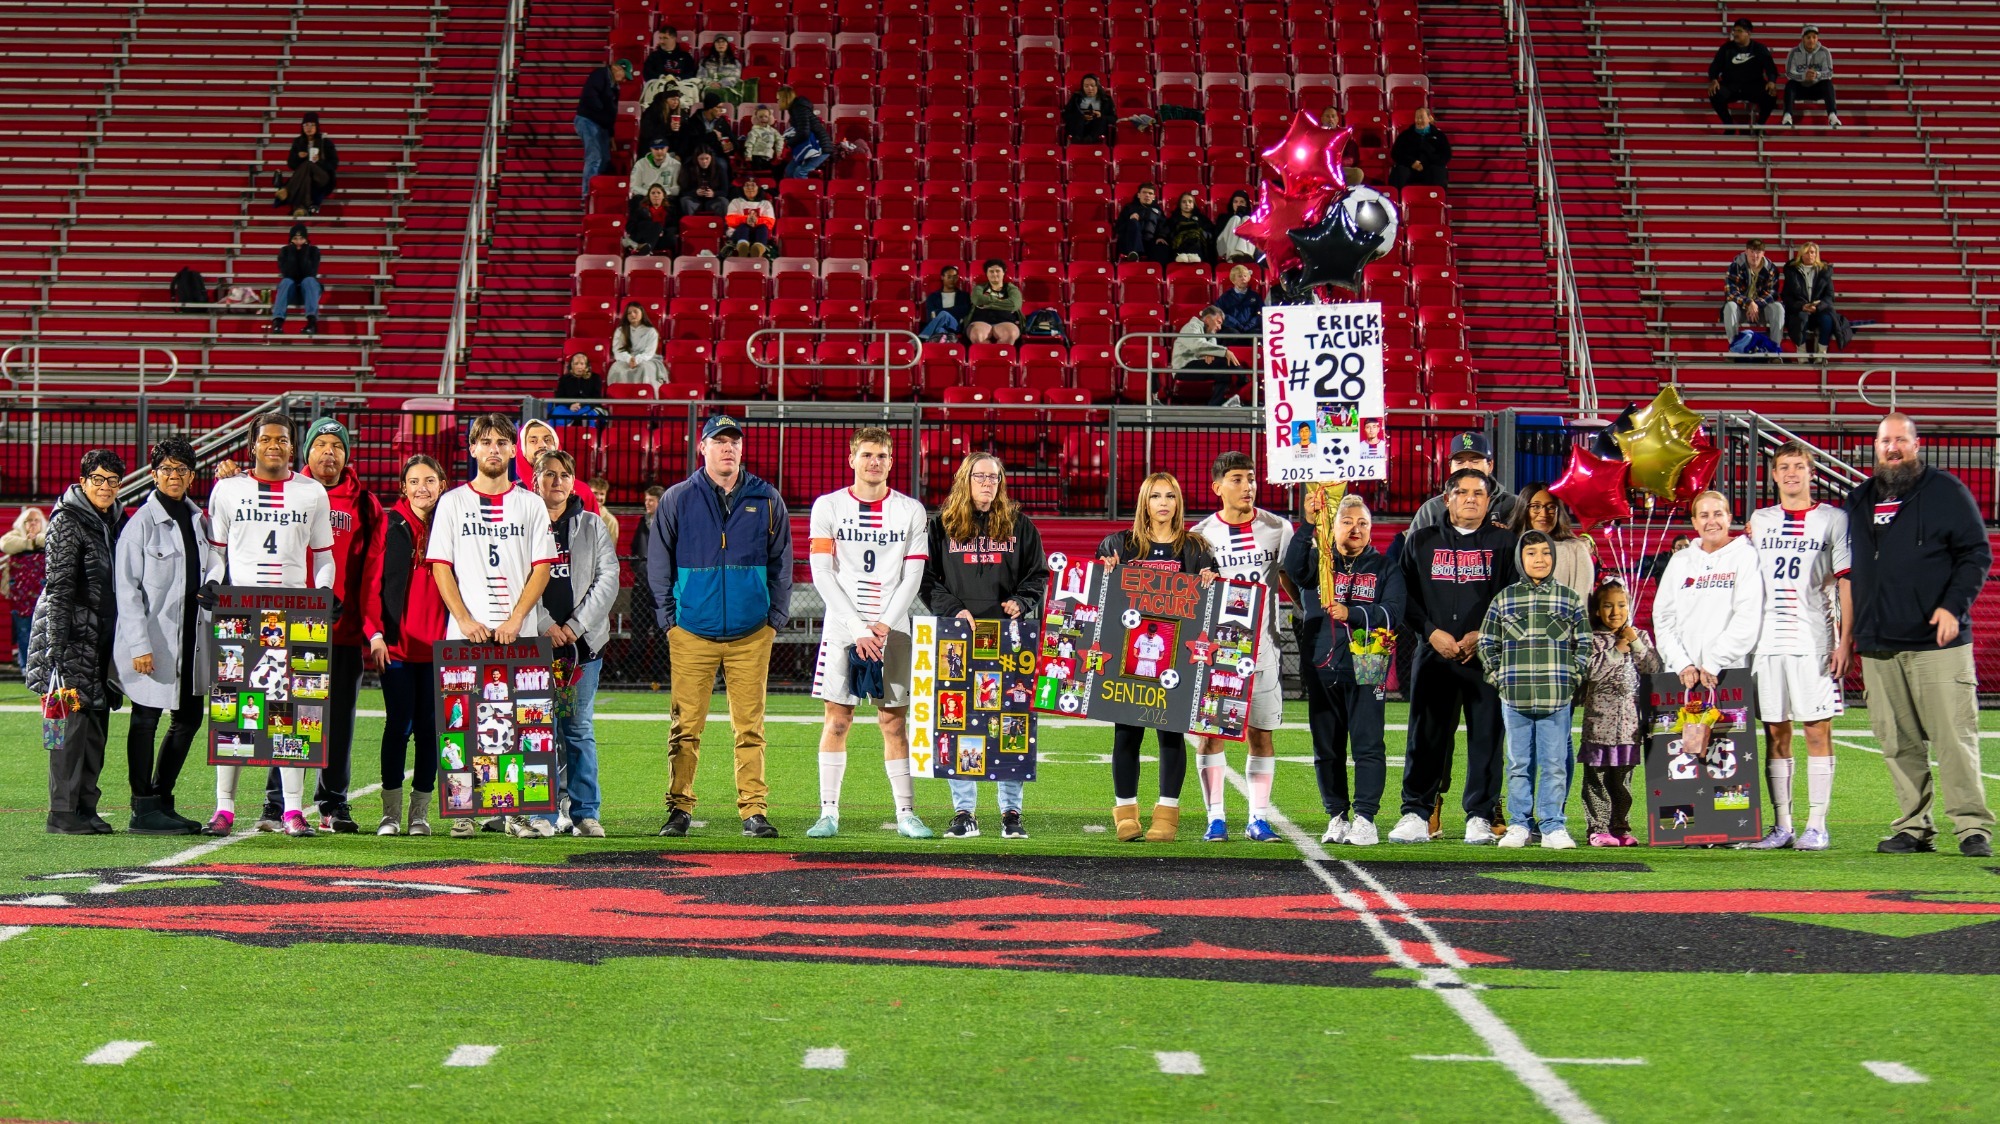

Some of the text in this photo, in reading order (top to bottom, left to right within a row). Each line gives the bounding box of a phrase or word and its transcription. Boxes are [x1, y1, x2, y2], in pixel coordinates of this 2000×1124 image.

[1317, 314, 1379, 331] ERICK
[1304, 330, 1380, 349] TACURI
[1268, 312, 1293, 448] SENIOR
[1288, 352, 1366, 400] #28
[1281, 465, 1375, 480] 2025 2026
[235, 508, 308, 526] Albright
[263, 530, 277, 554] 4
[461, 523, 525, 539] Albright
[836, 528, 906, 546] Albright
[489, 544, 500, 567] 5
[1761, 537, 1828, 553] Albright
[863, 549, 876, 573] 9
[1213, 548, 1279, 568] Albright
[1774, 557, 1802, 580] 26
[1121, 567, 1201, 600] ERICK
[241, 595, 327, 610] MITCHELL
[1126, 592, 1198, 620] TACURI
[999, 650, 1036, 675] #9
[911, 624, 933, 772] RAMSAY
[1101, 680, 1167, 709] SENIOR
[1137, 706, 1168, 725] 2026
